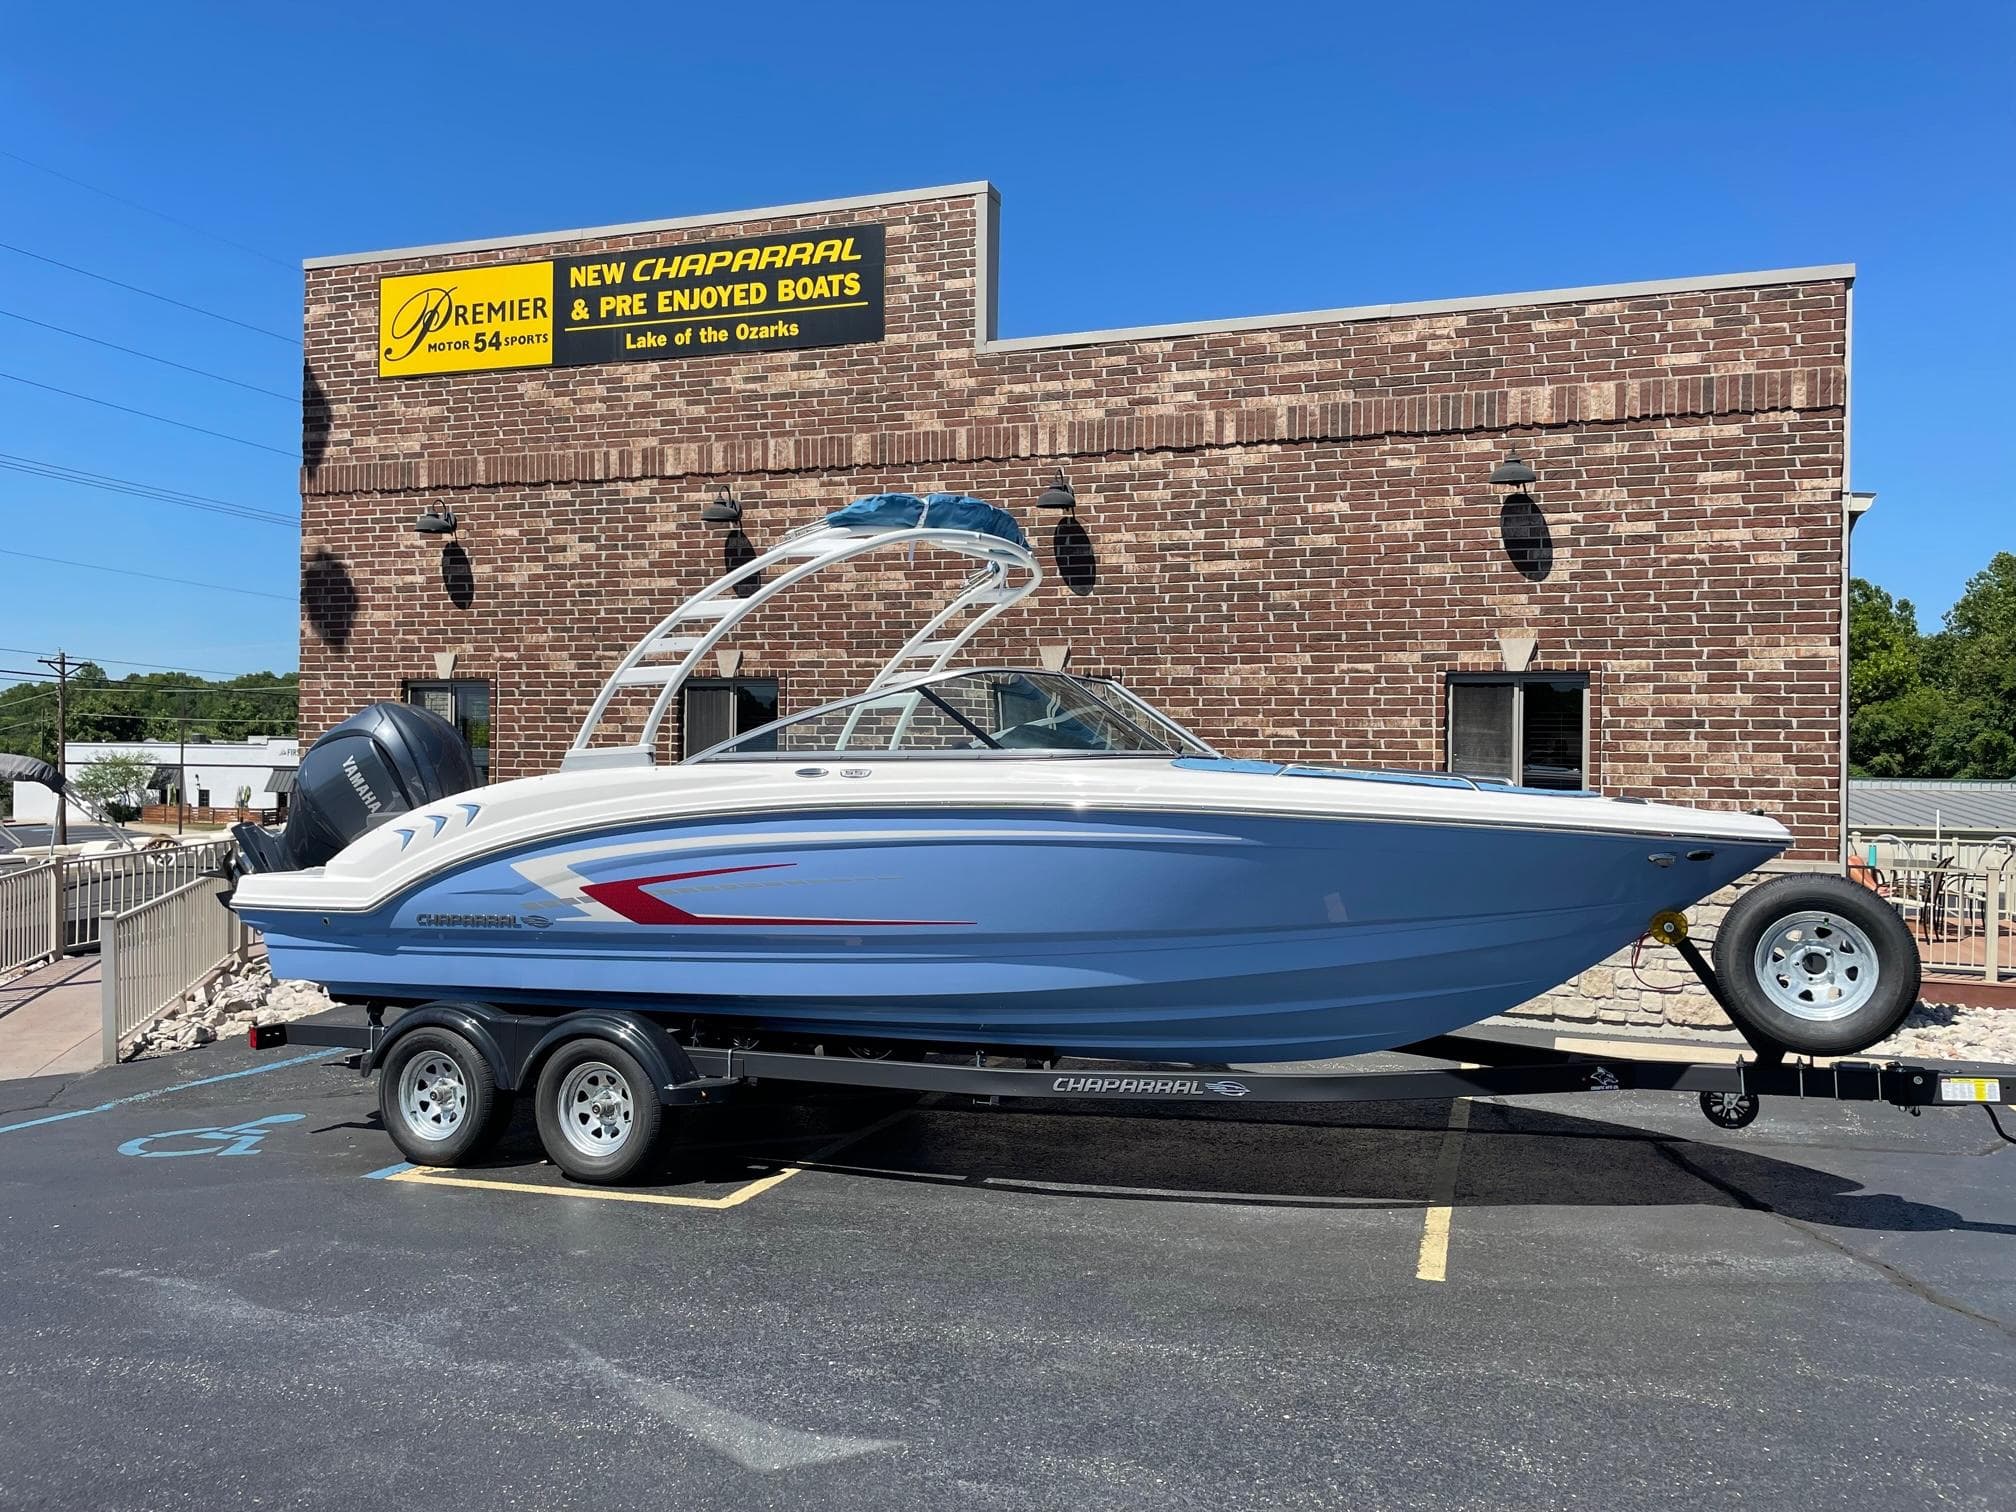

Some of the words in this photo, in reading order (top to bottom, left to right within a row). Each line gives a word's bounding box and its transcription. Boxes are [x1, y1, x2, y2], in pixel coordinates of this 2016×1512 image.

[570, 261, 626, 289] NEW
[632, 237, 862, 282] CHAPARRAL
[571, 298, 590, 321] &
[600, 293, 648, 319] PRE
[657, 282, 768, 313] ENJOYED
[777, 272, 861, 302] BOATS
[384, 286, 548, 362] PREMIER
[427, 340, 470, 353] MOTOR
[473, 330, 502, 353] 54
[504, 333, 549, 347] SPORTS
[625, 331, 667, 350] Lake
[674, 327, 692, 346] of
[699, 326, 729, 344] the
[735, 320, 799, 341] Ozarks
[342, 754, 382, 814] YAMAHA
[416, 912, 522, 929] CHAPARRAL
[1052, 1077, 1204, 1095] CHAPARRAL
